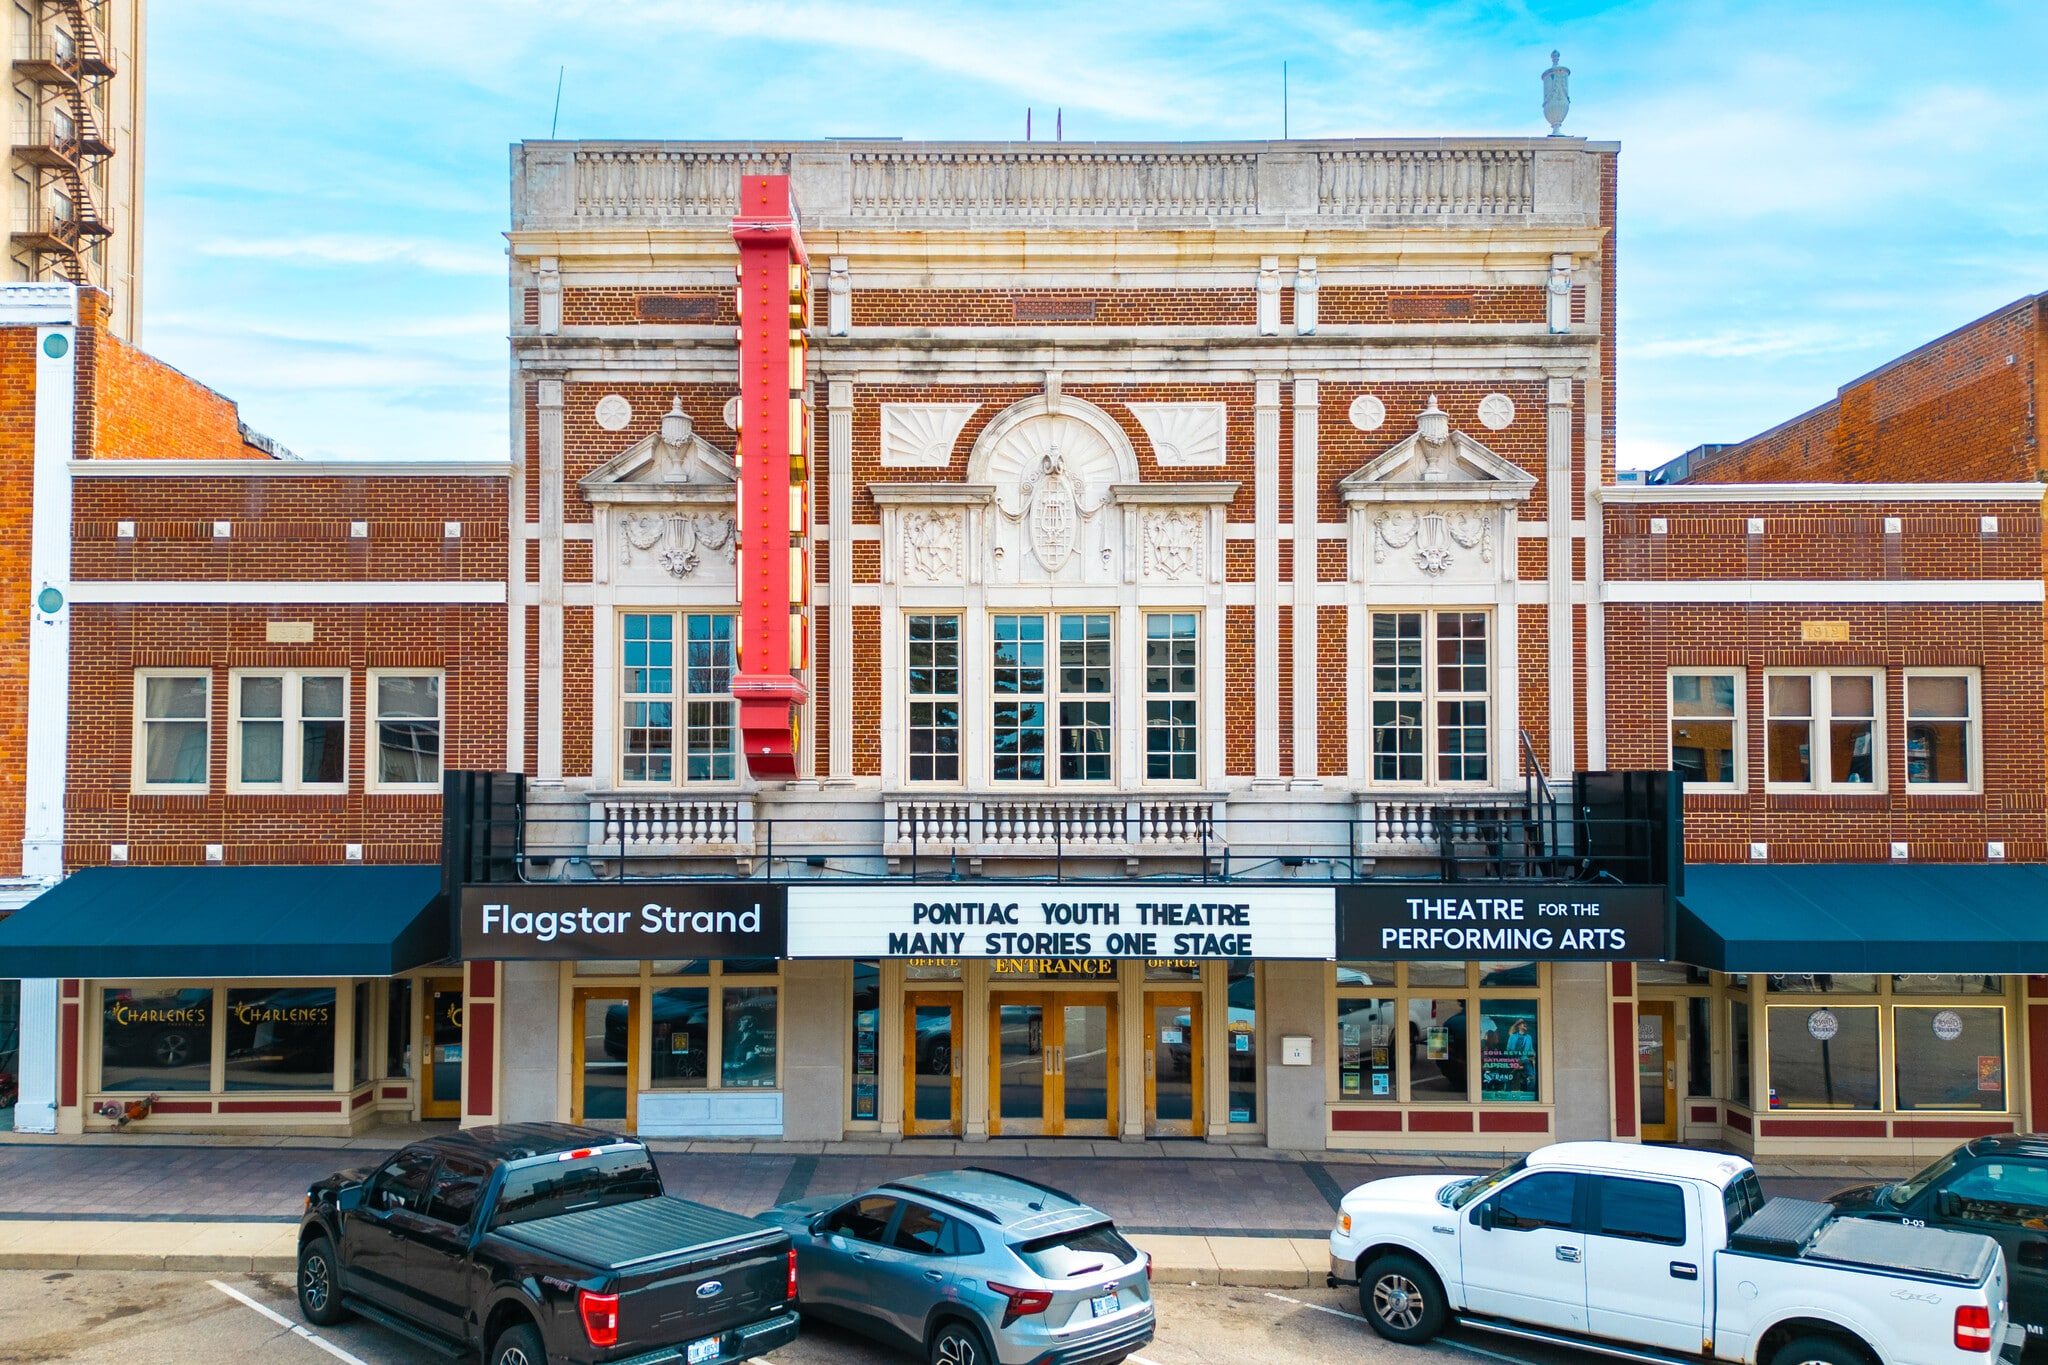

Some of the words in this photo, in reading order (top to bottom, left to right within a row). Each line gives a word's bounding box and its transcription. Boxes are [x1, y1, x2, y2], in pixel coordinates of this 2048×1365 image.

[913, 902, 1019, 925] PONTIAC
[1041, 902, 1120, 925] YOUTH
[1135, 903, 1250, 926] THEATRE
[1406, 898, 1524, 920] THEATRE
[1538, 903, 1568, 916] FOR
[1571, 903, 1600, 916] THE
[482, 904, 632, 942] Flagstar
[640, 903, 761, 934] Strand
[888, 932, 965, 955] MANY
[985, 932, 1092, 955] STORIES
[1106, 932, 1157, 955] ONE
[1174, 933, 1253, 955] STAGE
[1382, 928, 1553, 950] PERFORMING
[1559, 928, 1626, 950] ARTS
[909, 958, 959, 967] OFFICE
[995, 959, 1112, 974] ENTRANCE
[1147, 959, 1198, 968] OFFICE
[117, 1006, 206, 1026] CHARLENE'S
[239, 1005, 329, 1025] CHARLENE'S
[1902, 1217, 1925, 1227] D-03
[2026, 1323, 2044, 1335] MI
